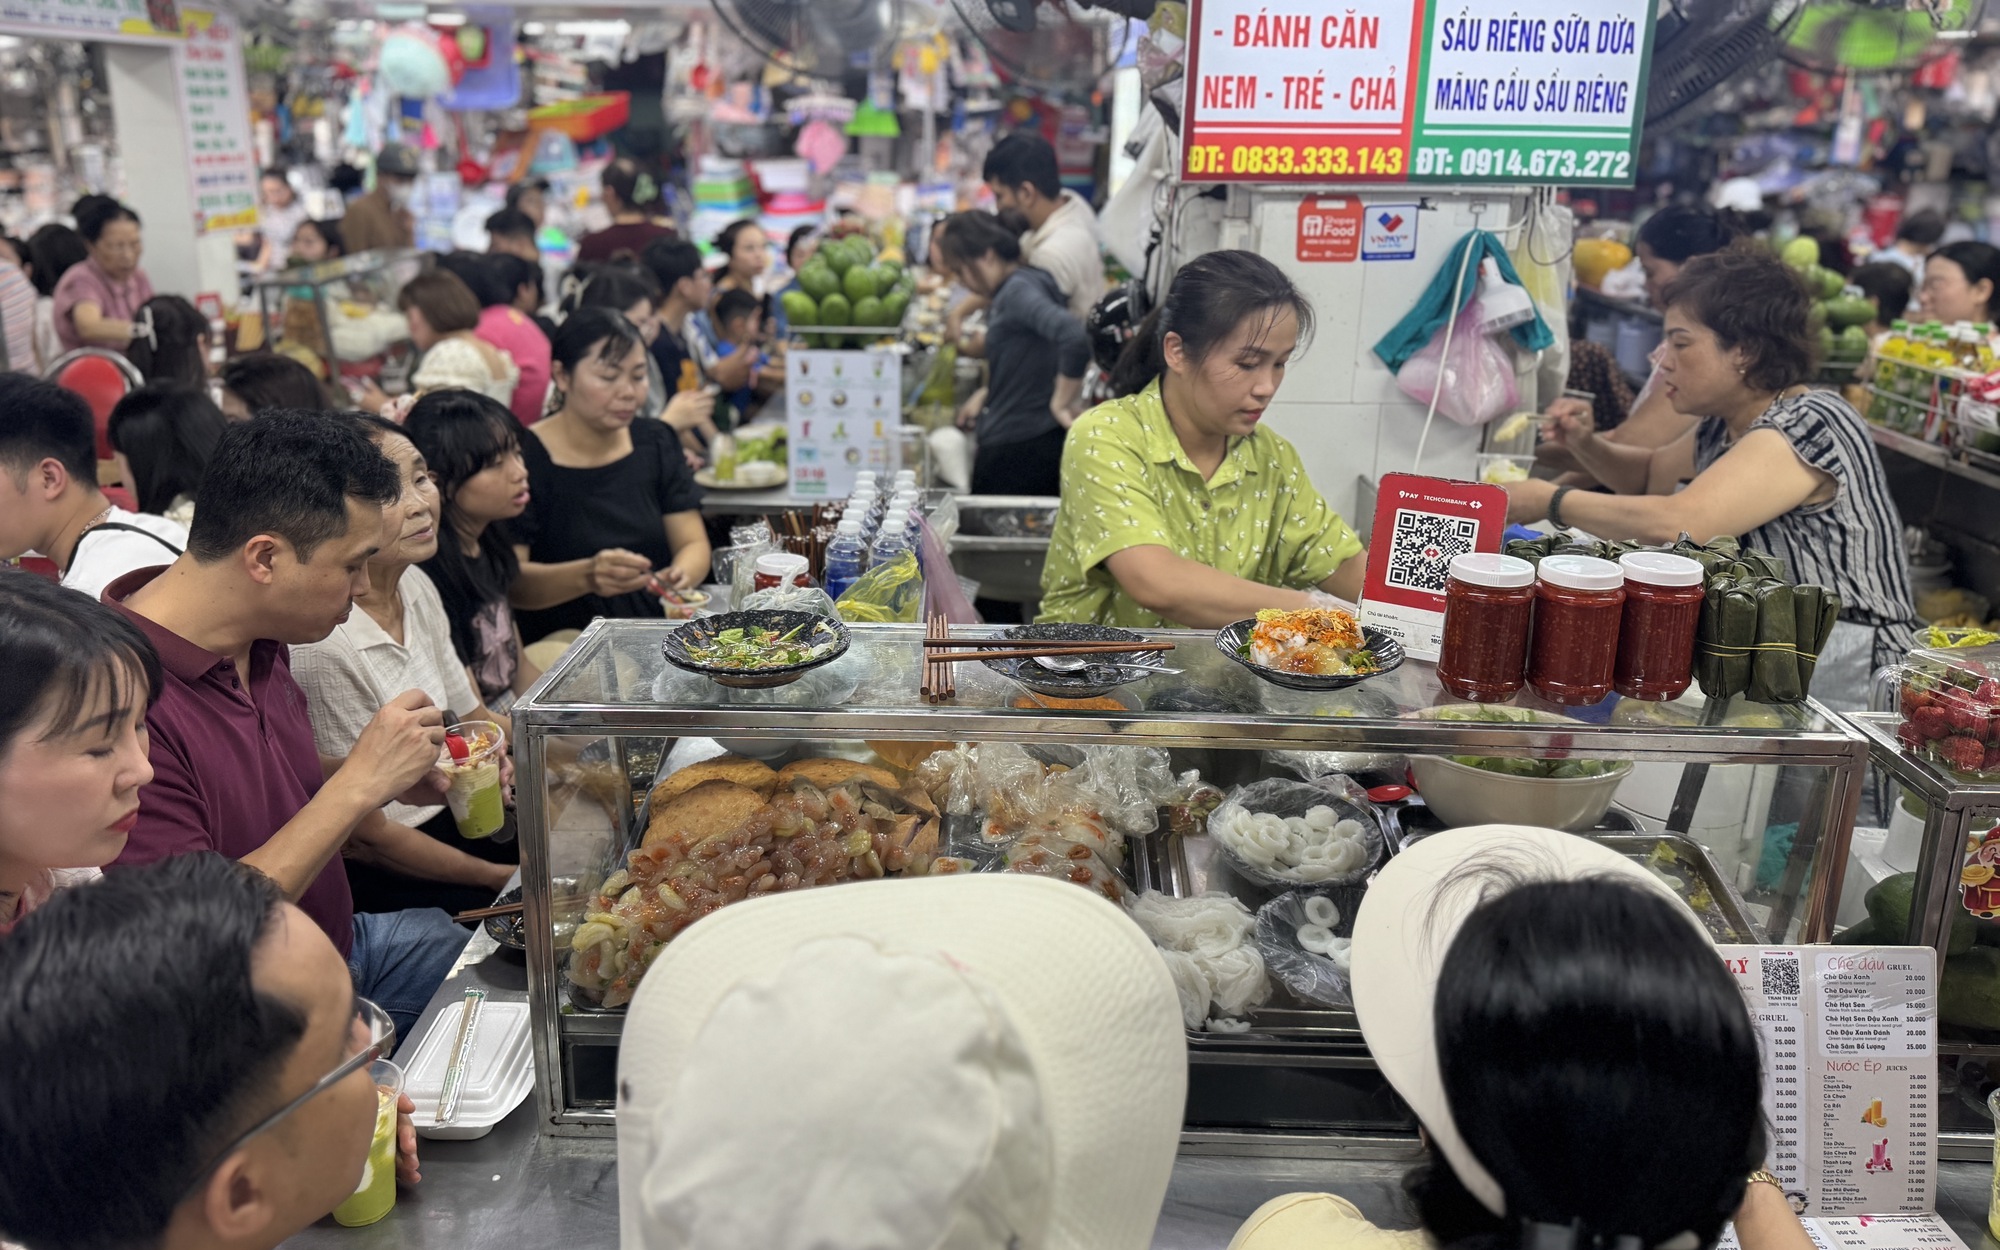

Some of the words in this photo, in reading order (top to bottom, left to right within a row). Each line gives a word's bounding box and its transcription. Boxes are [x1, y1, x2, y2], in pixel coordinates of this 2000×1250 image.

[1233, 7, 1311, 48] BÁNH
[1320, 8, 1379, 48] CĂN
[1442, 6, 1481, 51] SẦU
[1486, 11, 1546, 52] RIÊNG
[1552, 13, 1590, 54] SỮA
[1596, 13, 1636, 54] DỪA
[1202, 75, 1257, 109] NEM
[1283, 68, 1325, 110] TRÉ
[1349, 65, 1396, 110] CHẢ
[1435, 71, 1489, 112] MÃNG
[1493, 66, 1530, 112] CẦU
[1534, 67, 1570, 112] SẦU
[1574, 73, 1628, 114] RIÊNG
[1188, 145, 1225, 174] ĐT:
[1231, 145, 1403, 176] 0833.333.143
[1416, 147, 1454, 176] ĐT:
[1460, 148, 1632, 179] 0914.673.272
[1324, 224, 1356, 236] Food
[1398, 490, 1419, 499] 9PAY
[1424, 495, 1468, 506] TECHCOMBANK
[1828, 956, 1854, 970] Chè
[1827, 1060, 1859, 1071] Nước
[1864, 1059, 1882, 1074] Ép
